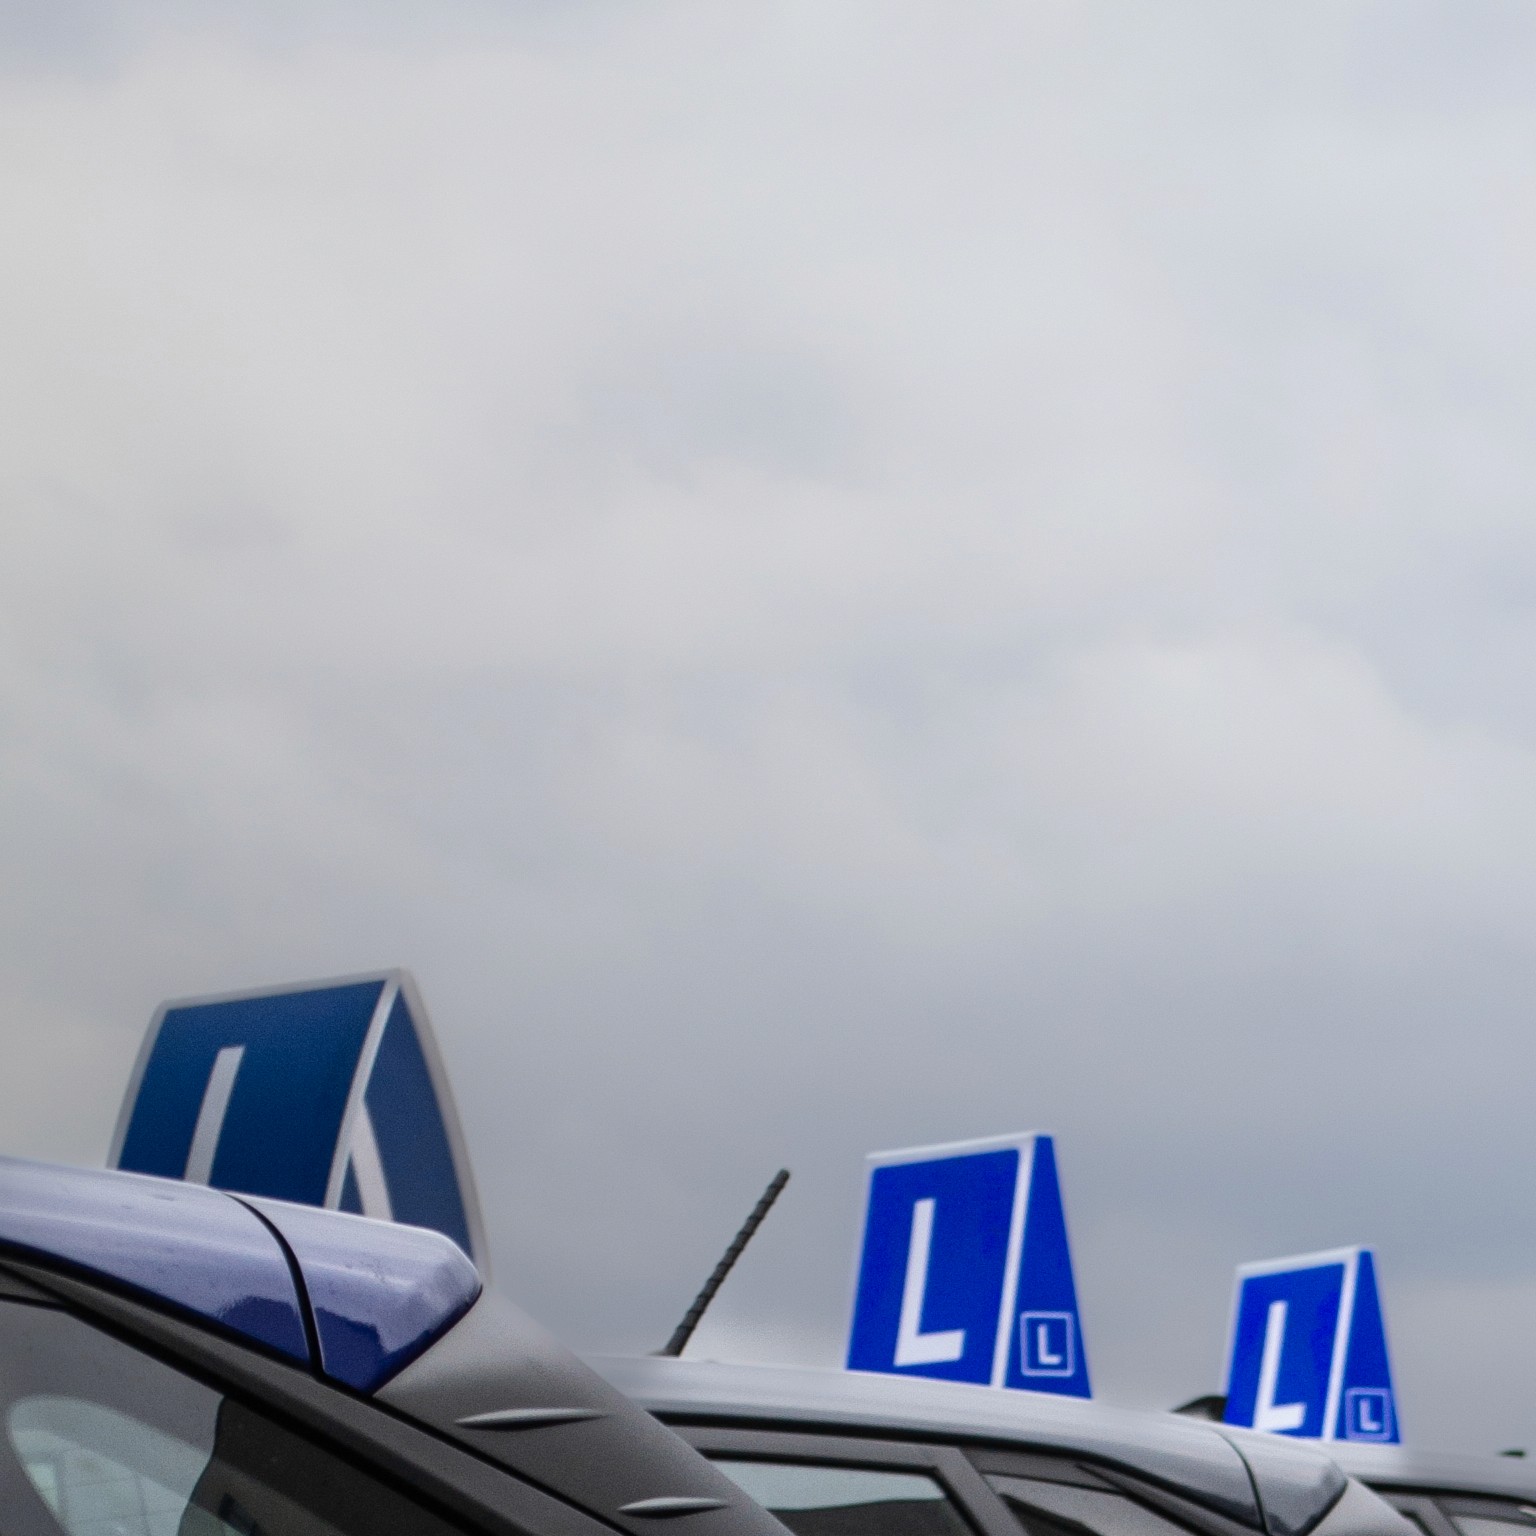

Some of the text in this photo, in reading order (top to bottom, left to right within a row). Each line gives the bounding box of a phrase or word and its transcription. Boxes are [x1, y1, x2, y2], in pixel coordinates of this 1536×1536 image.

[893, 1198, 965, 1367] L
[1037, 1325, 1061, 1364] L
[1252, 1301, 1306, 1432] L
[1358, 1399, 1381, 1432] L
